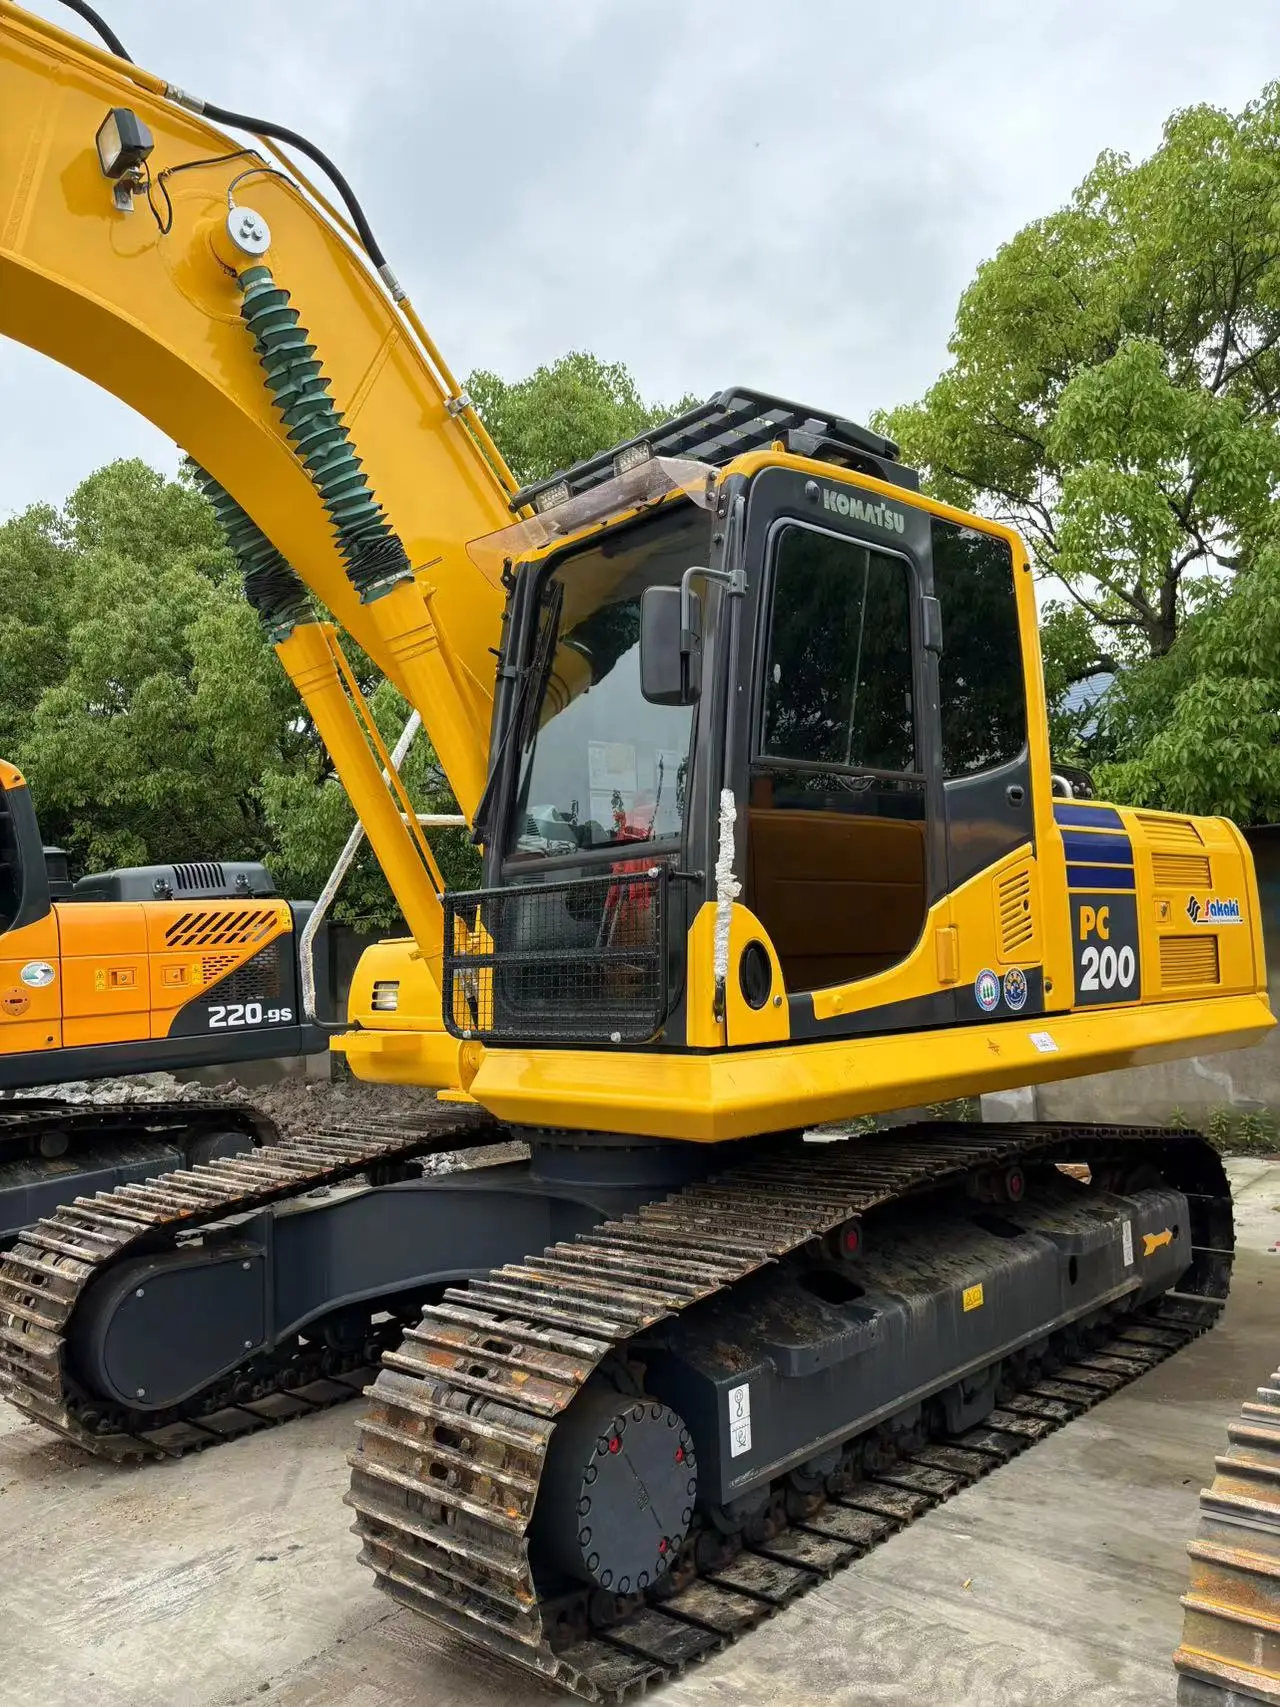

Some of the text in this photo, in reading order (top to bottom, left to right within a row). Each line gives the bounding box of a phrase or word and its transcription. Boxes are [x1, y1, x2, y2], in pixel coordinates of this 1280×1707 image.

[823, 488, 905, 534] KOMATSU
[1080, 905, 1110, 940] PC
[1204, 899, 1239, 916] Sakaki
[1080, 945, 1136, 990] 200
